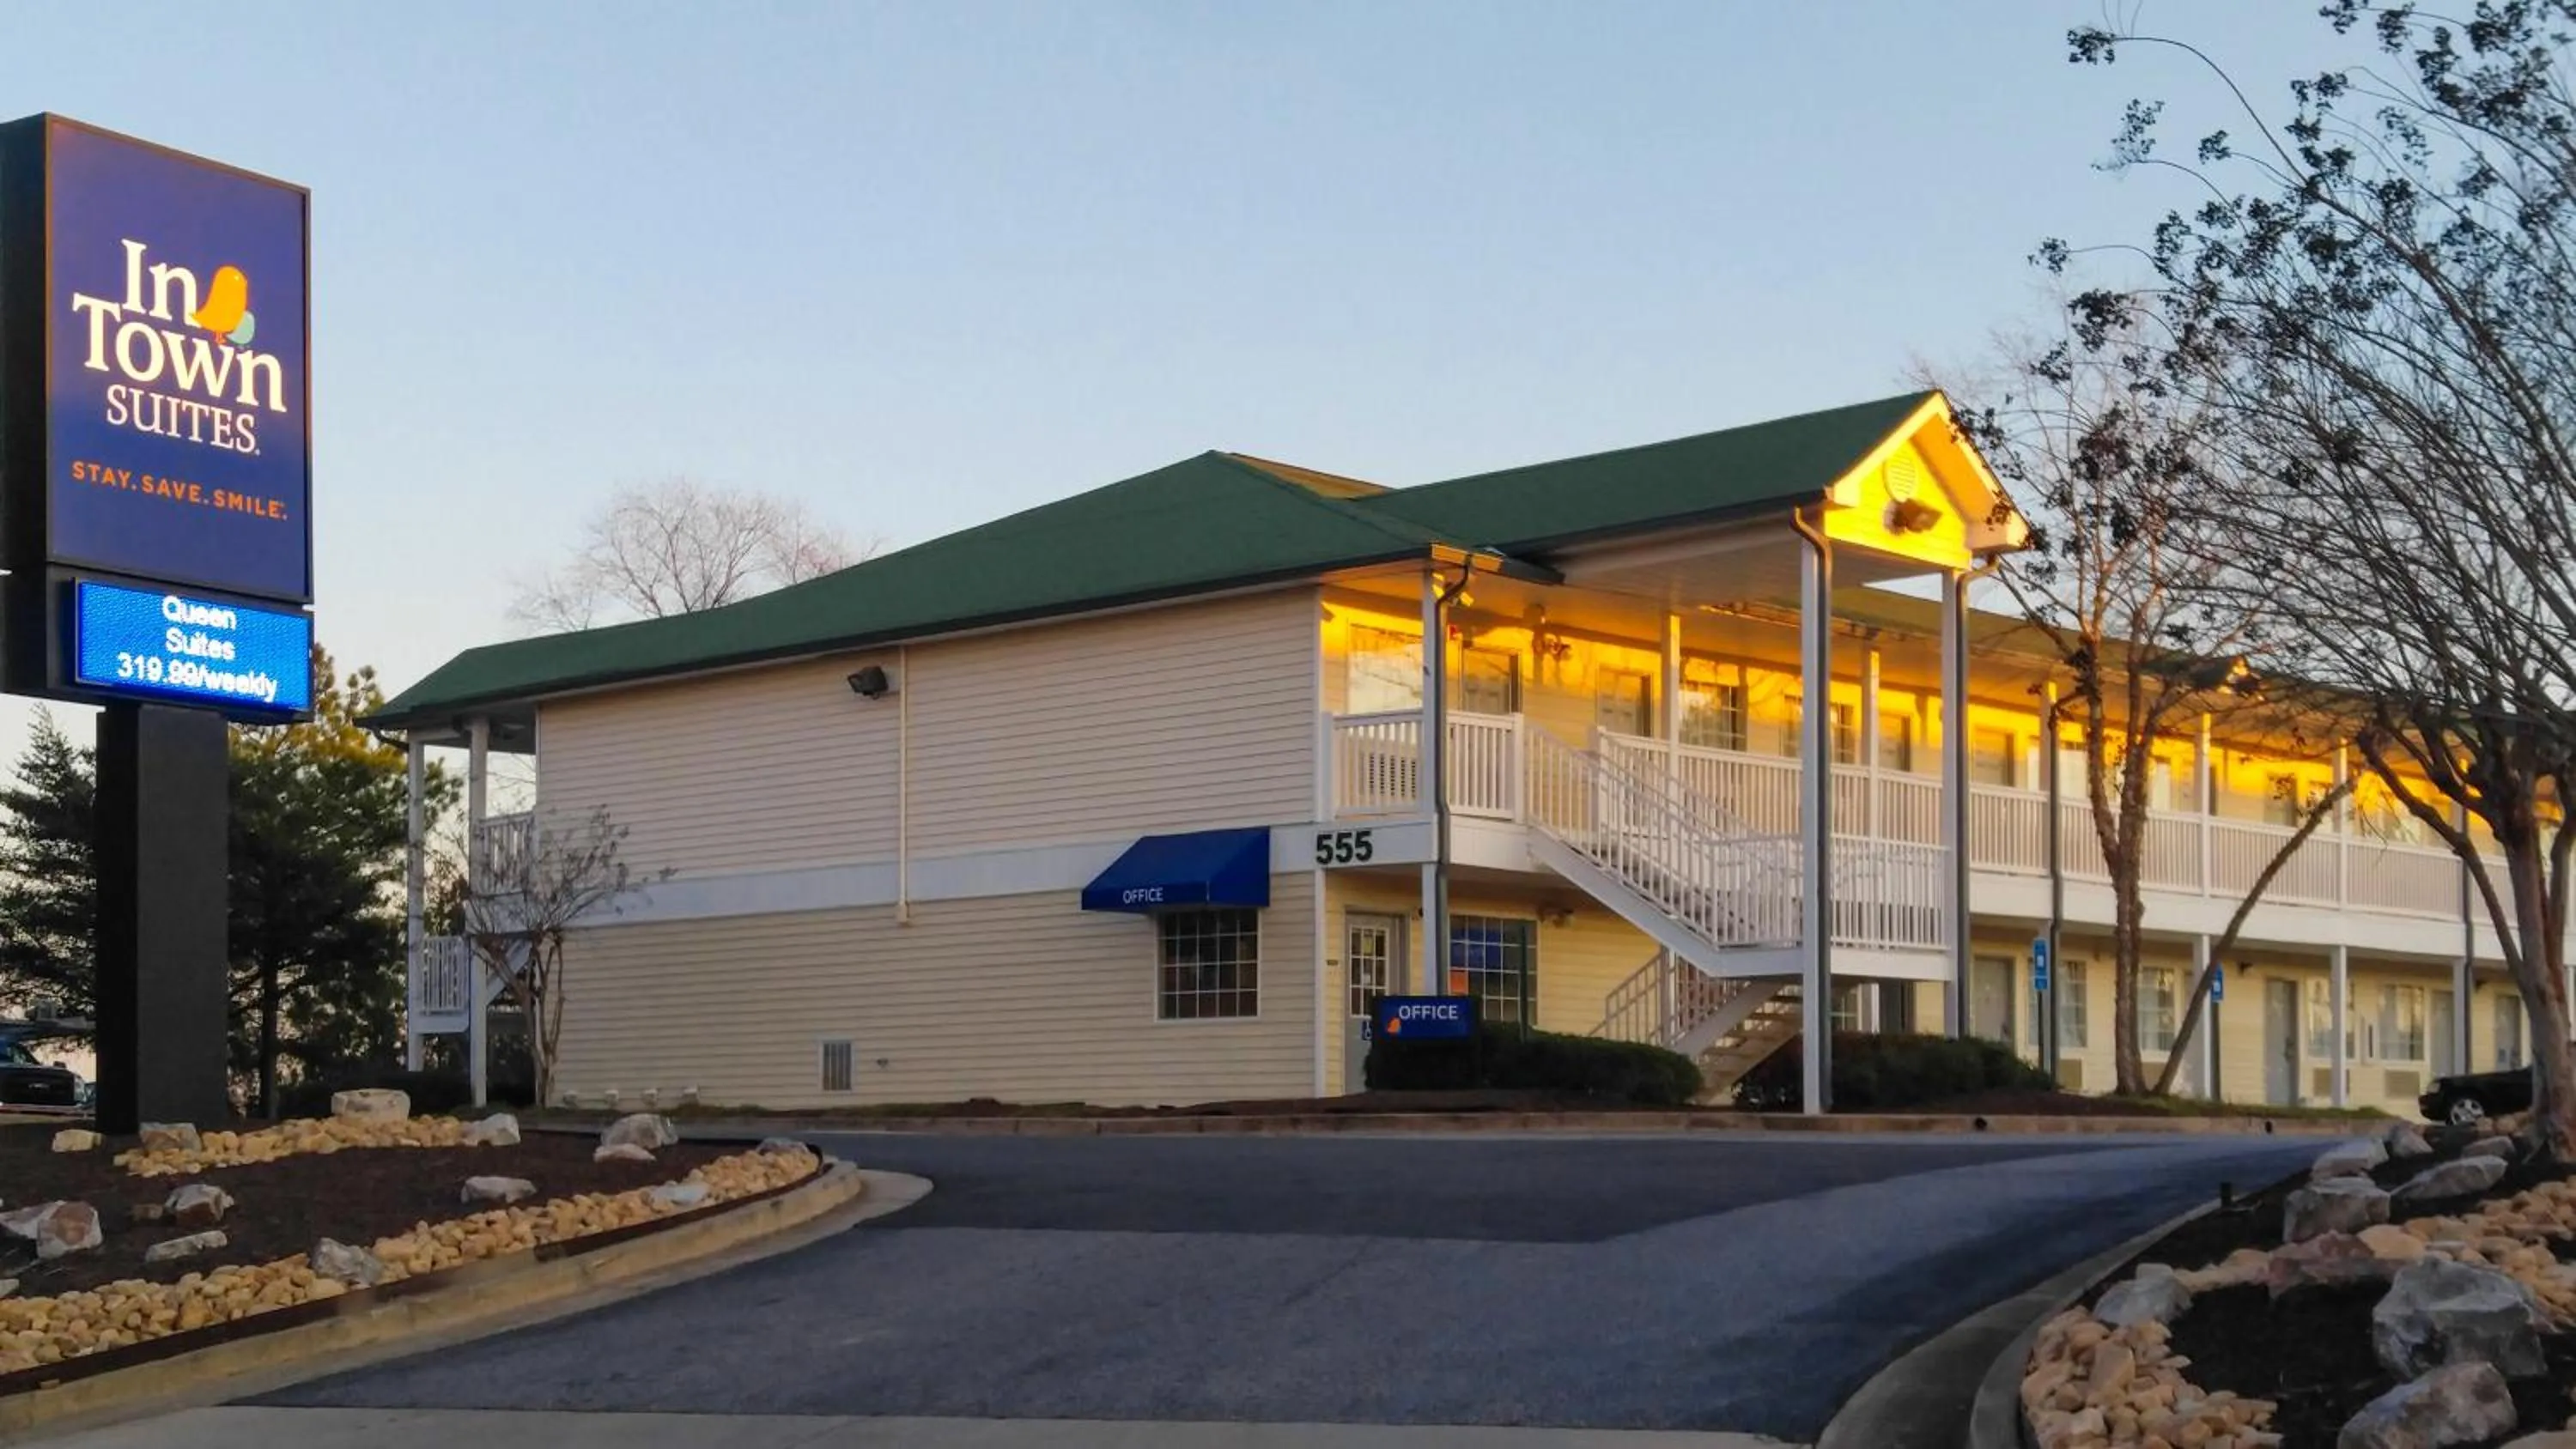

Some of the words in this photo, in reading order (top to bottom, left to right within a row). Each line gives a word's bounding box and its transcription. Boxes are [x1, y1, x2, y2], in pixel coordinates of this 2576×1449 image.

[121, 239, 201, 329] In
[72, 292, 288, 413] Town
[162, 595, 237, 631] Queen
[166, 627, 235, 661] Suites
[1315, 830, 1374, 865] 555
[1123, 888, 1163, 904] OFFICE
[1398, 1004, 1459, 1021] OFFICE
